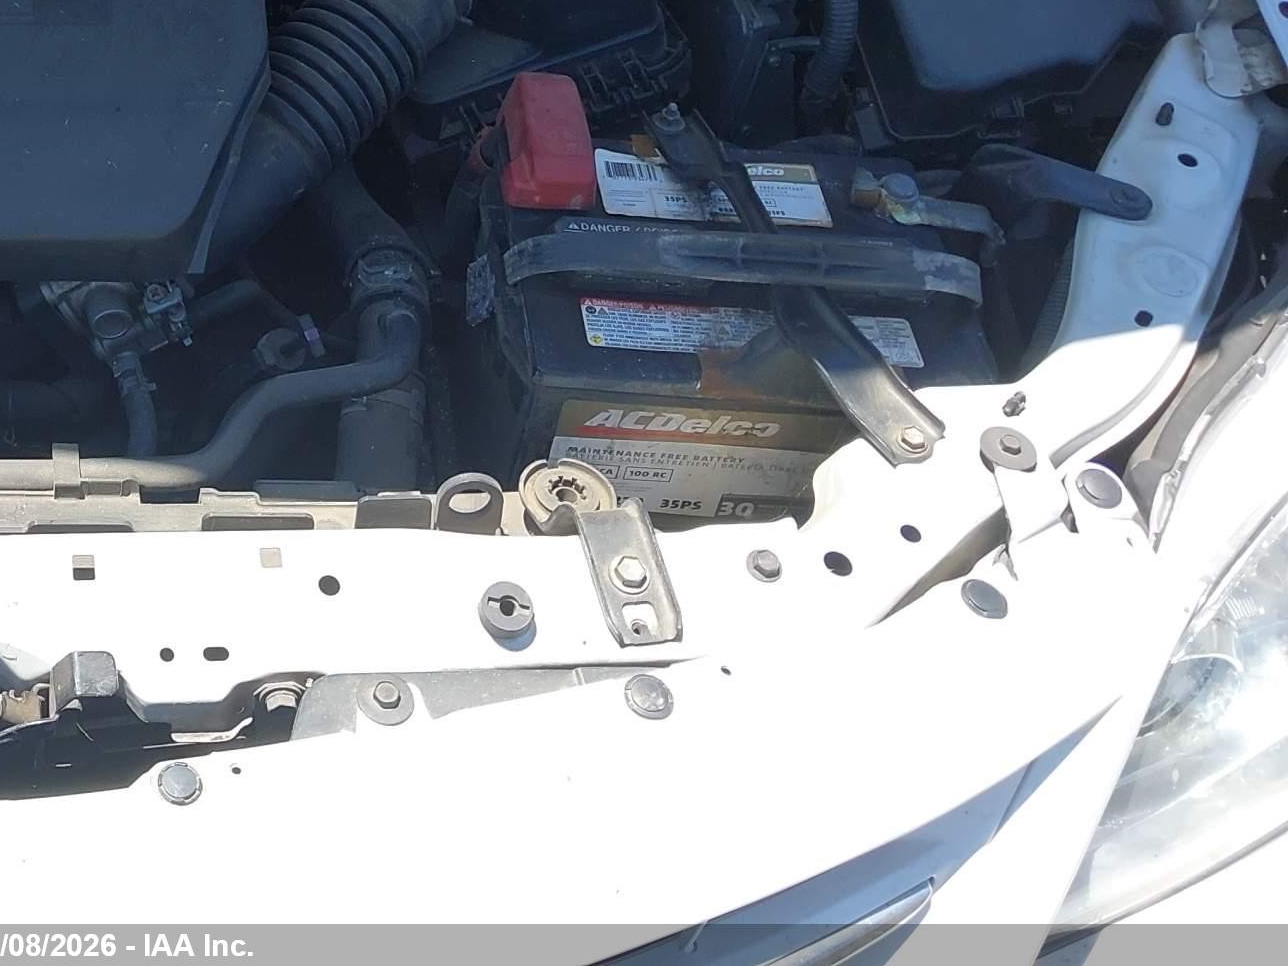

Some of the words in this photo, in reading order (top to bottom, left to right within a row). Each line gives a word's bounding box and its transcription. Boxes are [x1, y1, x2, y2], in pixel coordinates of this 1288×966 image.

[747, 166, 785, 176] elco
[583, 409, 781, 438] ACDelco
[567, 446, 656, 457] MAINTENANCE
[660, 453, 689, 461] FREE
[694, 455, 745, 463] BATTERY
[629, 470, 649, 478] 100
[652, 471, 667, 479] RC
[660, 498, 702, 511] 35PS
